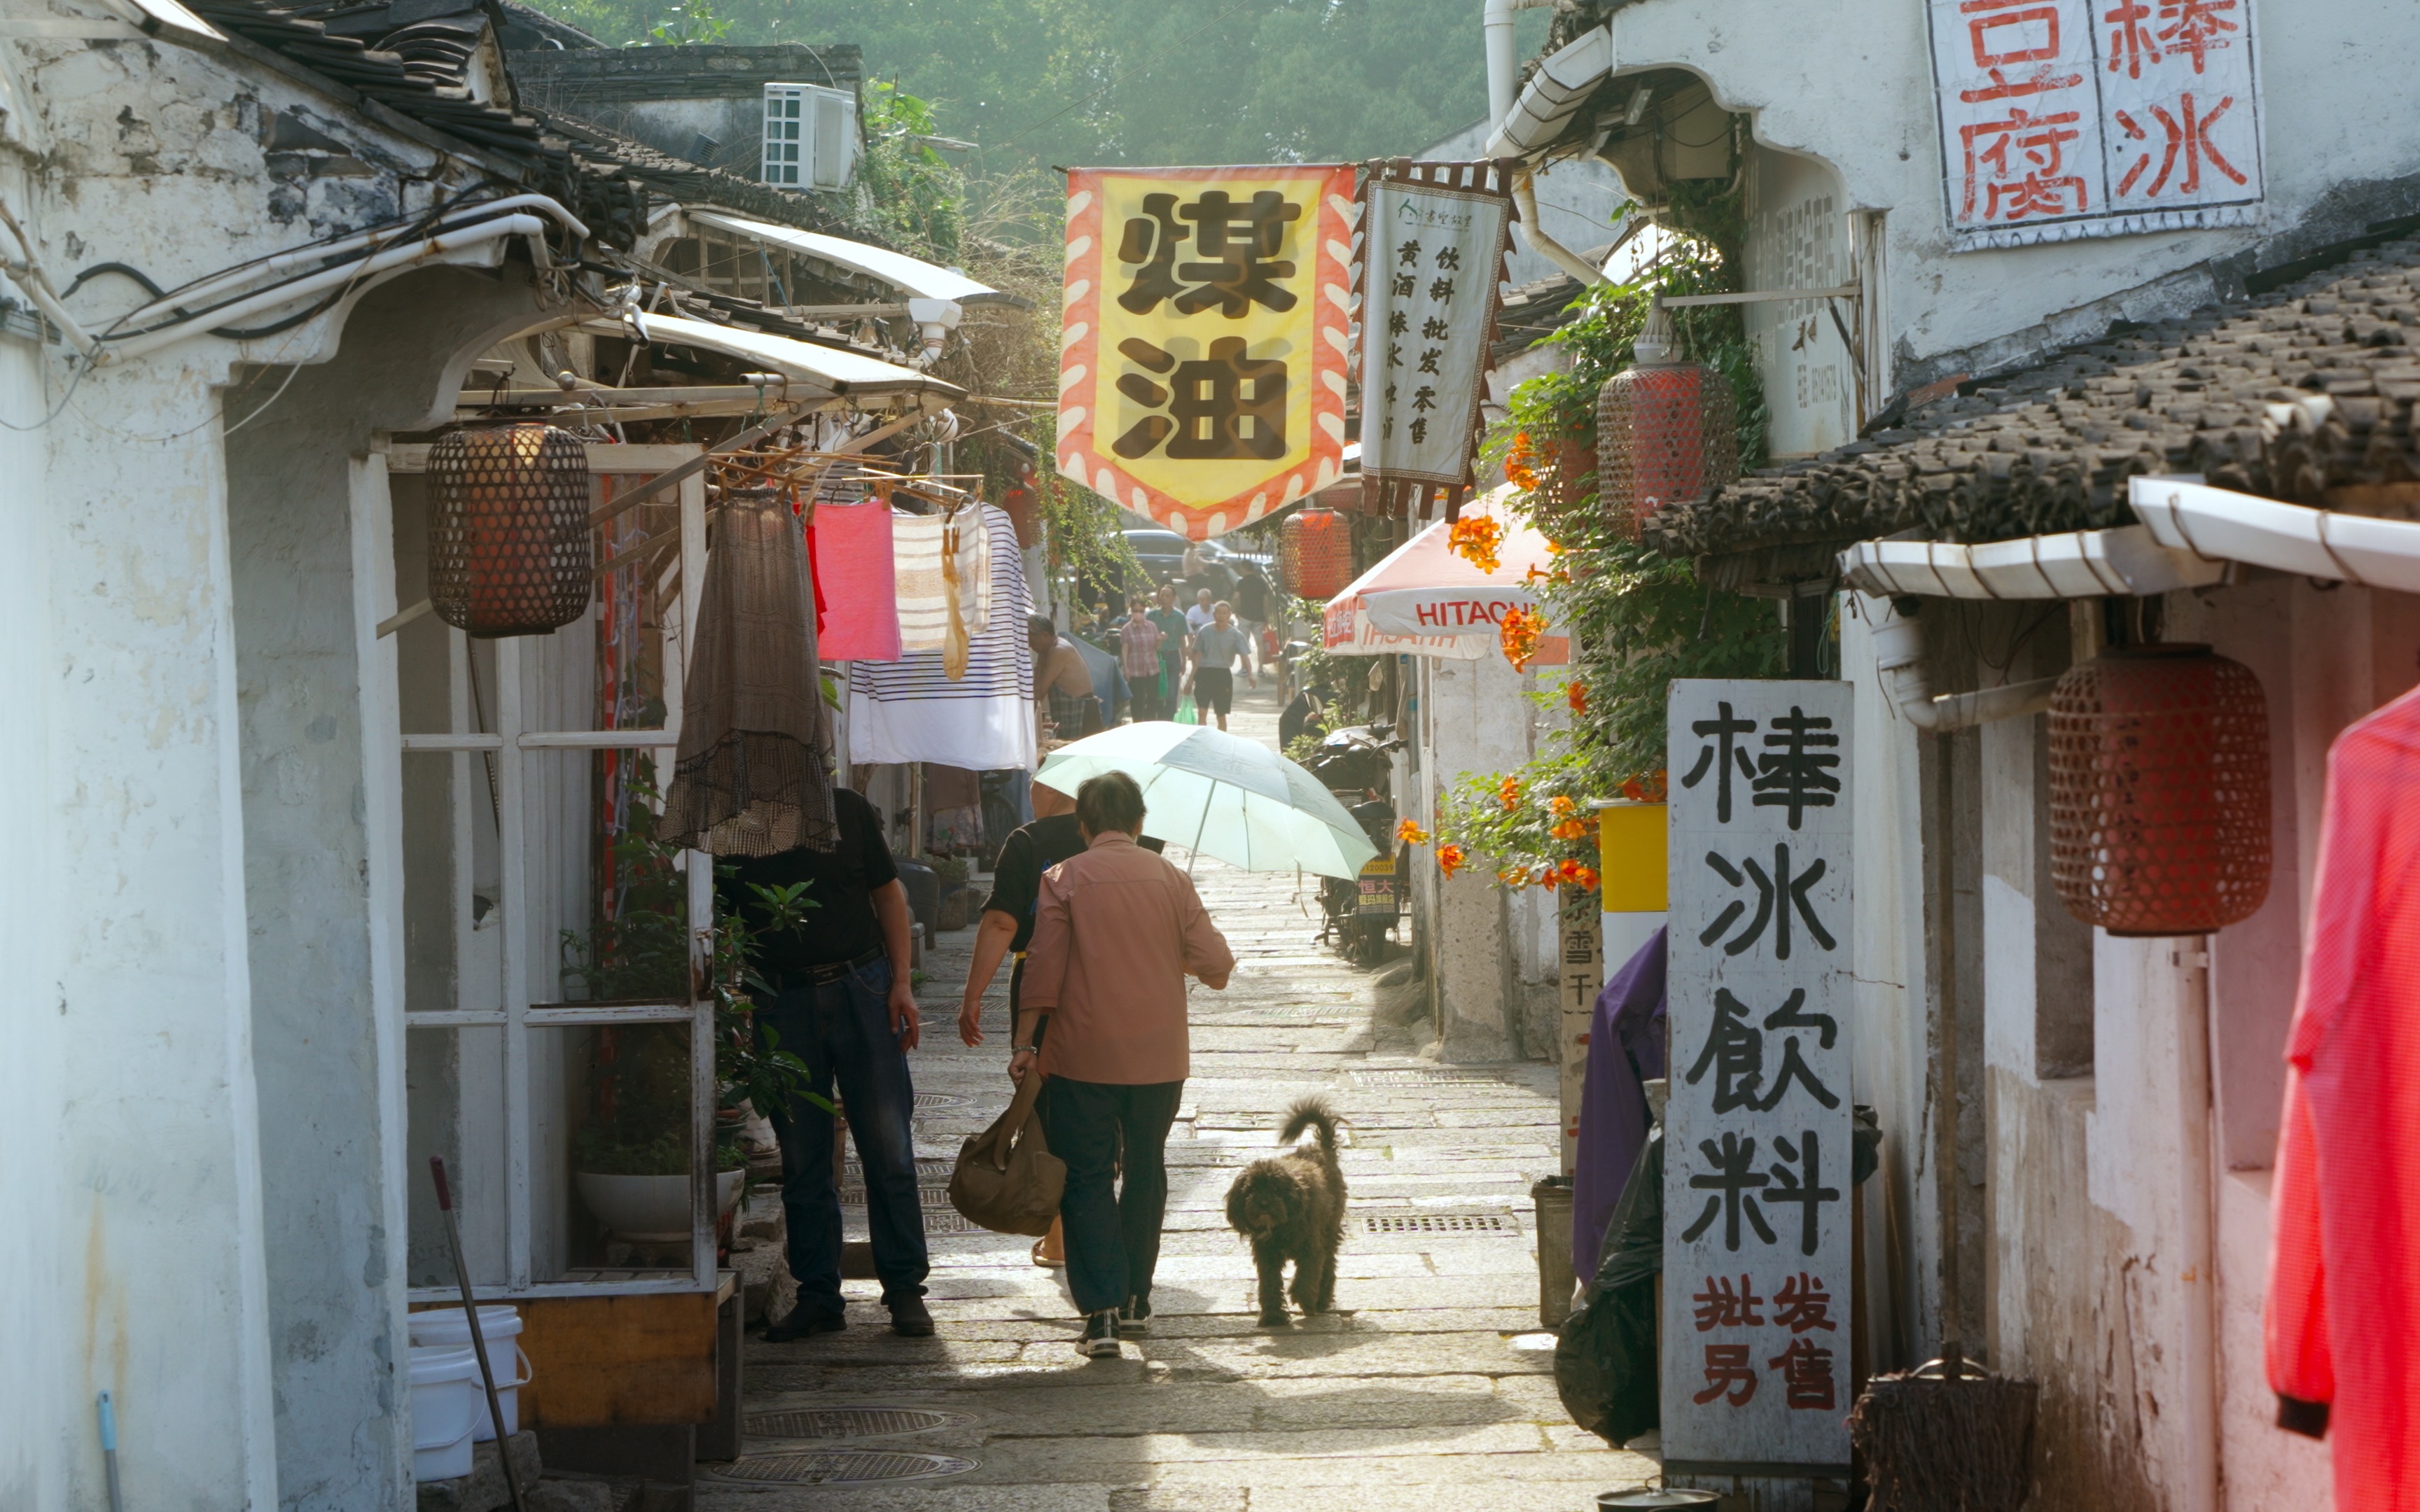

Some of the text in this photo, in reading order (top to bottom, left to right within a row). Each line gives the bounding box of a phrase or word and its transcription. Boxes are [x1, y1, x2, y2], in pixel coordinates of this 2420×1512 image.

[1959, 0, 2088, 222] 豆腐
[2104, 0, 2247, 197] 棒冰
[1112, 190, 1302, 459] 煤油
[1409, 246, 1460, 444] 饮料批发零售
[1358, 879, 1394, 894] 恒大
[1681, 701, 1842, 1256] 棒冰飲料
[1692, 1272, 1837, 1334] 批发
[1692, 1338, 1836, 1410] 另售
